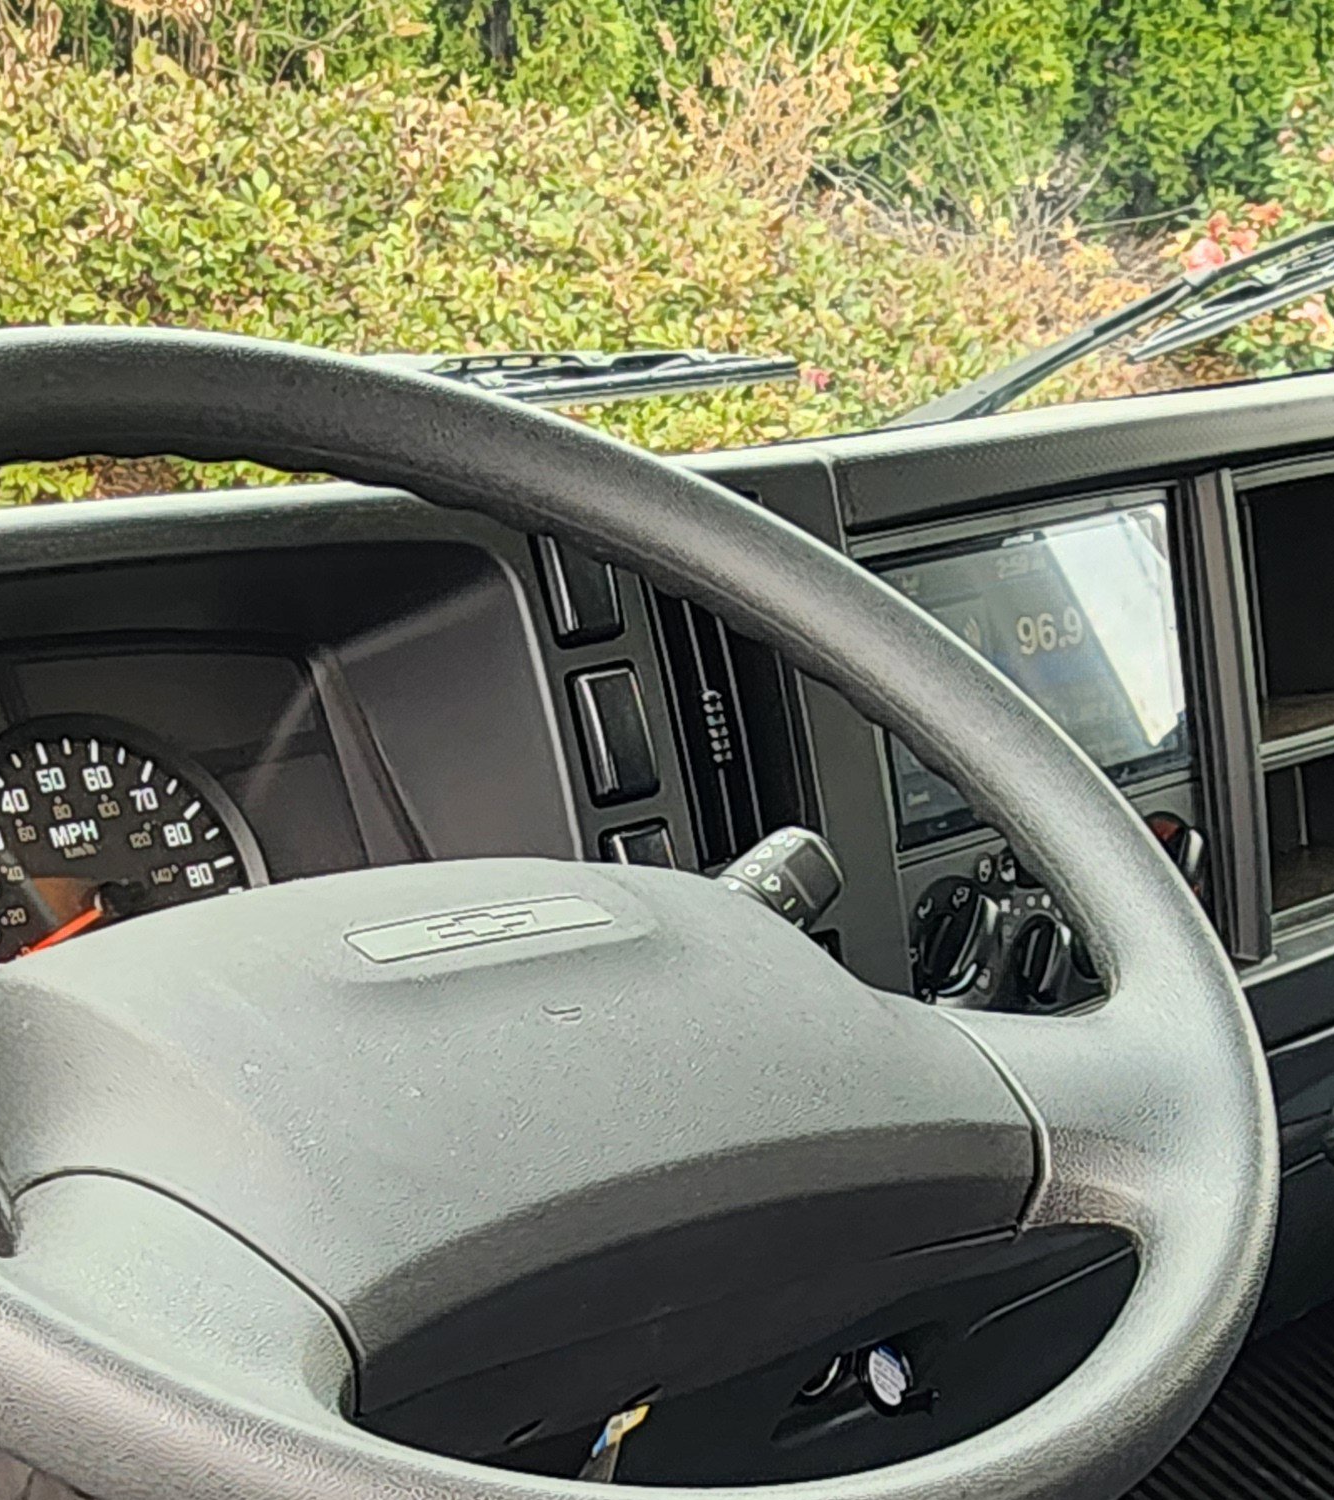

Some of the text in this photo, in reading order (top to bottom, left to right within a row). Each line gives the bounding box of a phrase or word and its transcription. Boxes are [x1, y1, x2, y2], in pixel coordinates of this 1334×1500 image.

[1017, 606, 1083, 655] 96.9
[36, 767, 66, 793] 50
[82, 765, 113, 791] 60
[1, 788, 30, 814] 40
[97, 801, 120, 818] 100
[130, 787, 158, 812] 70
[49, 819, 99, 848] MPH
[130, 832, 152, 848] 120
[163, 822, 192, 848] 80
[7, 865, 24, 881] 40
[186, 862, 214, 888] 90
[7, 908, 27, 926] 20
